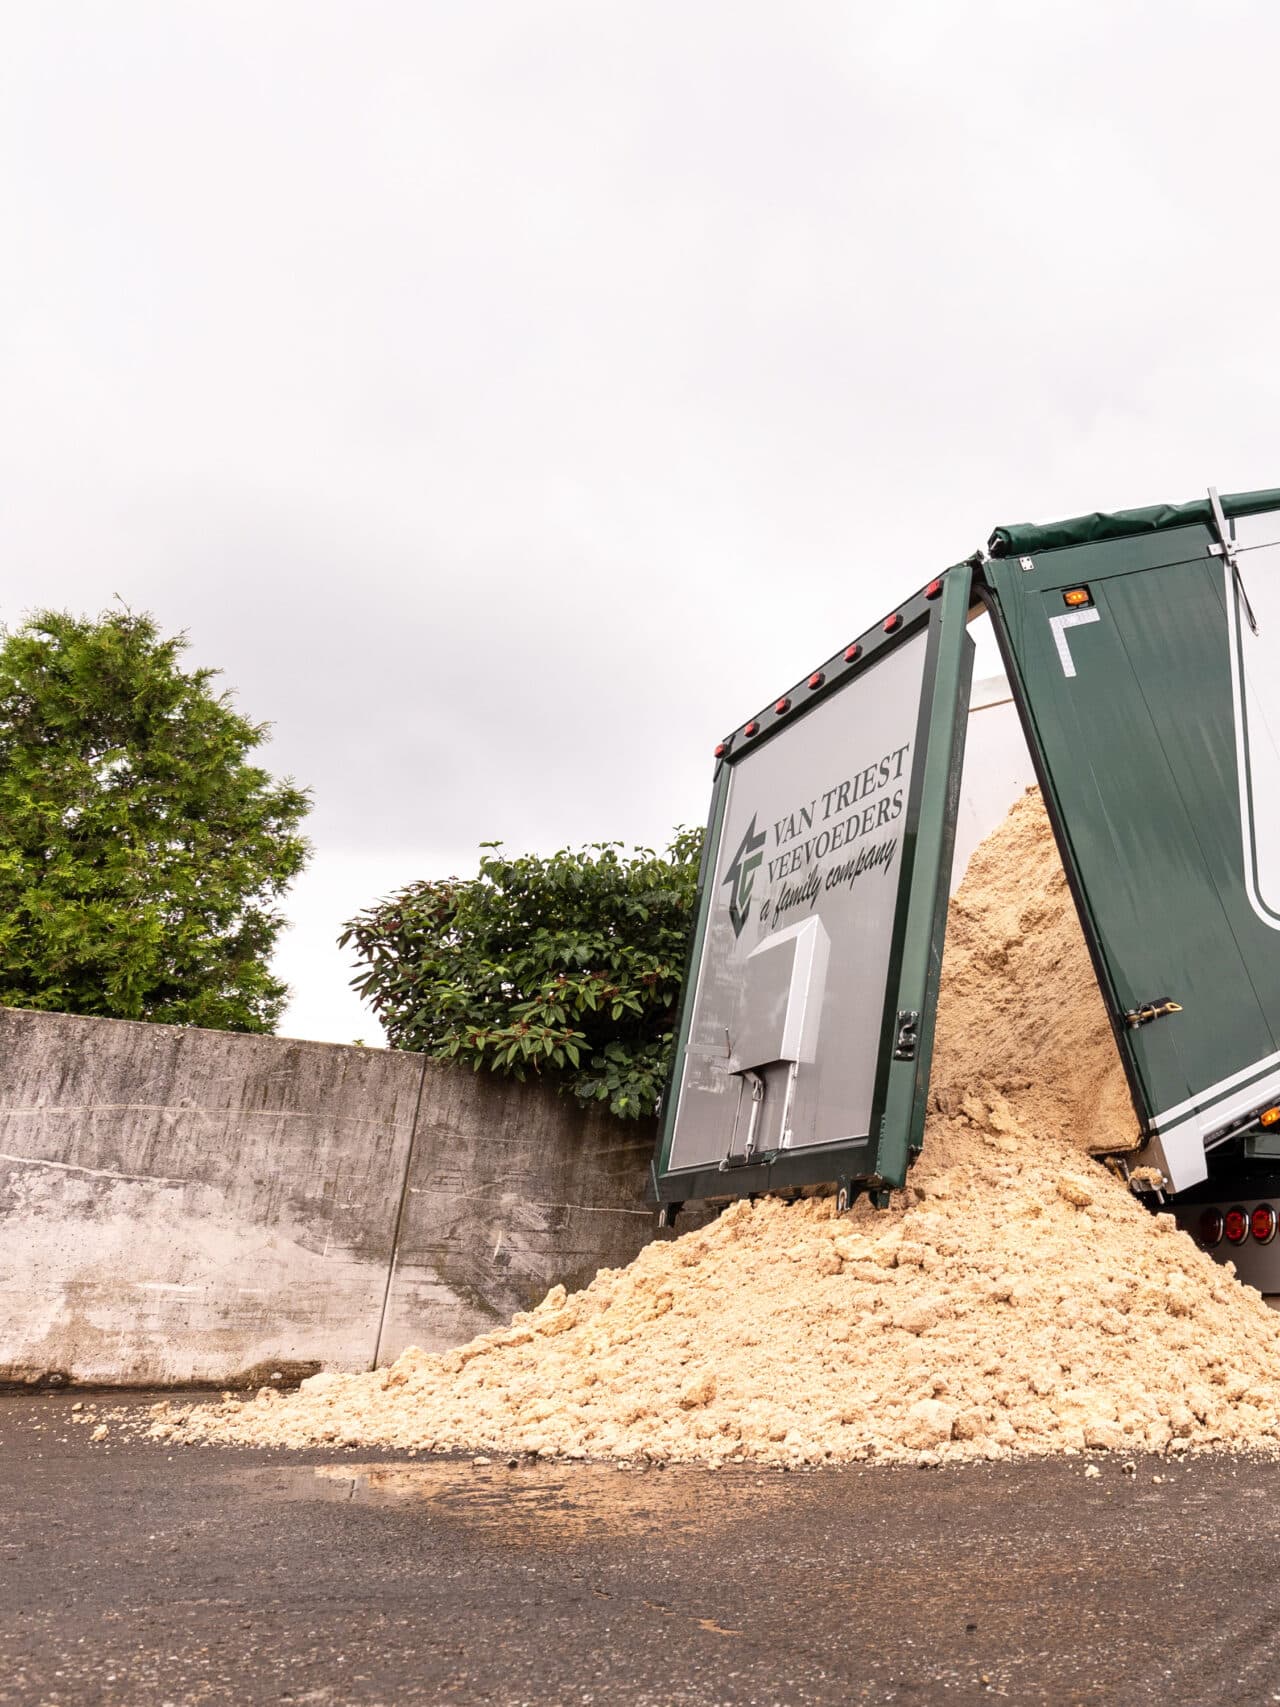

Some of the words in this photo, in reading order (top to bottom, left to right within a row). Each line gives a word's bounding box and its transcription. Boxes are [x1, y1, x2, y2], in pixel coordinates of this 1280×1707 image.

[767, 788, 903, 884] VEEVOEDERS
[773, 800, 817, 847] VAN
[821, 742, 910, 821] TRIEST
[759, 899, 771, 922] a
[771, 864, 823, 930] family
[825, 837, 898, 891] company
